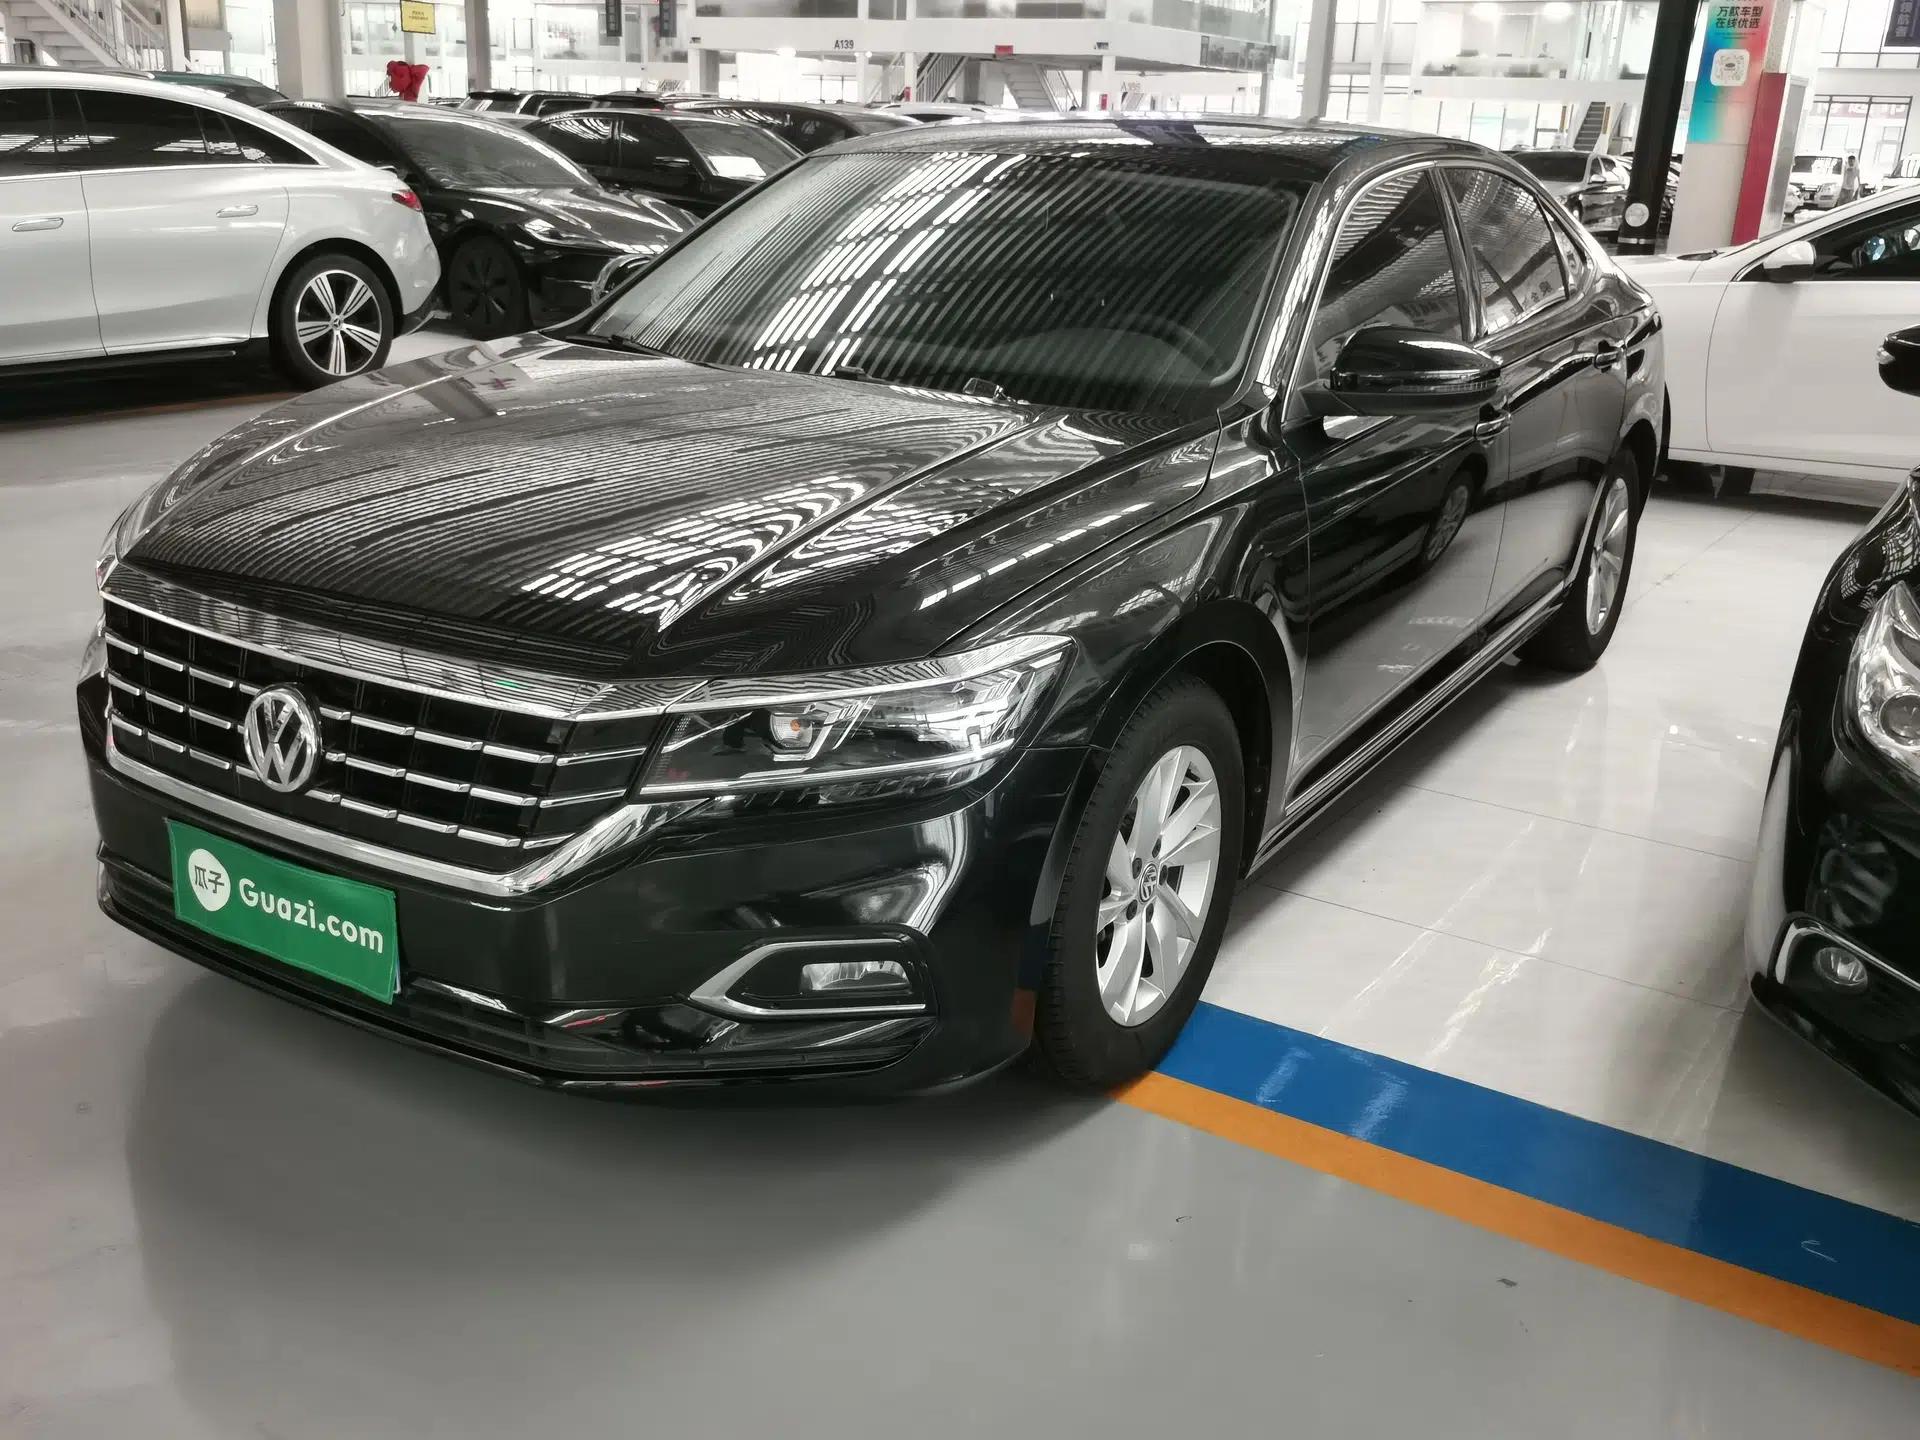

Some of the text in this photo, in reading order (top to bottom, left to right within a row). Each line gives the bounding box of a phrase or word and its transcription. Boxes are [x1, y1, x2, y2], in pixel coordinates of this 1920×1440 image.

[1717, 6, 1763, 17] 万款车型
[1716, 18, 1760, 28] 在线优选
[834, 39, 854, 49] A139
[194, 864, 225, 894] 瓜子
[239, 877, 384, 954] Guazi.com
